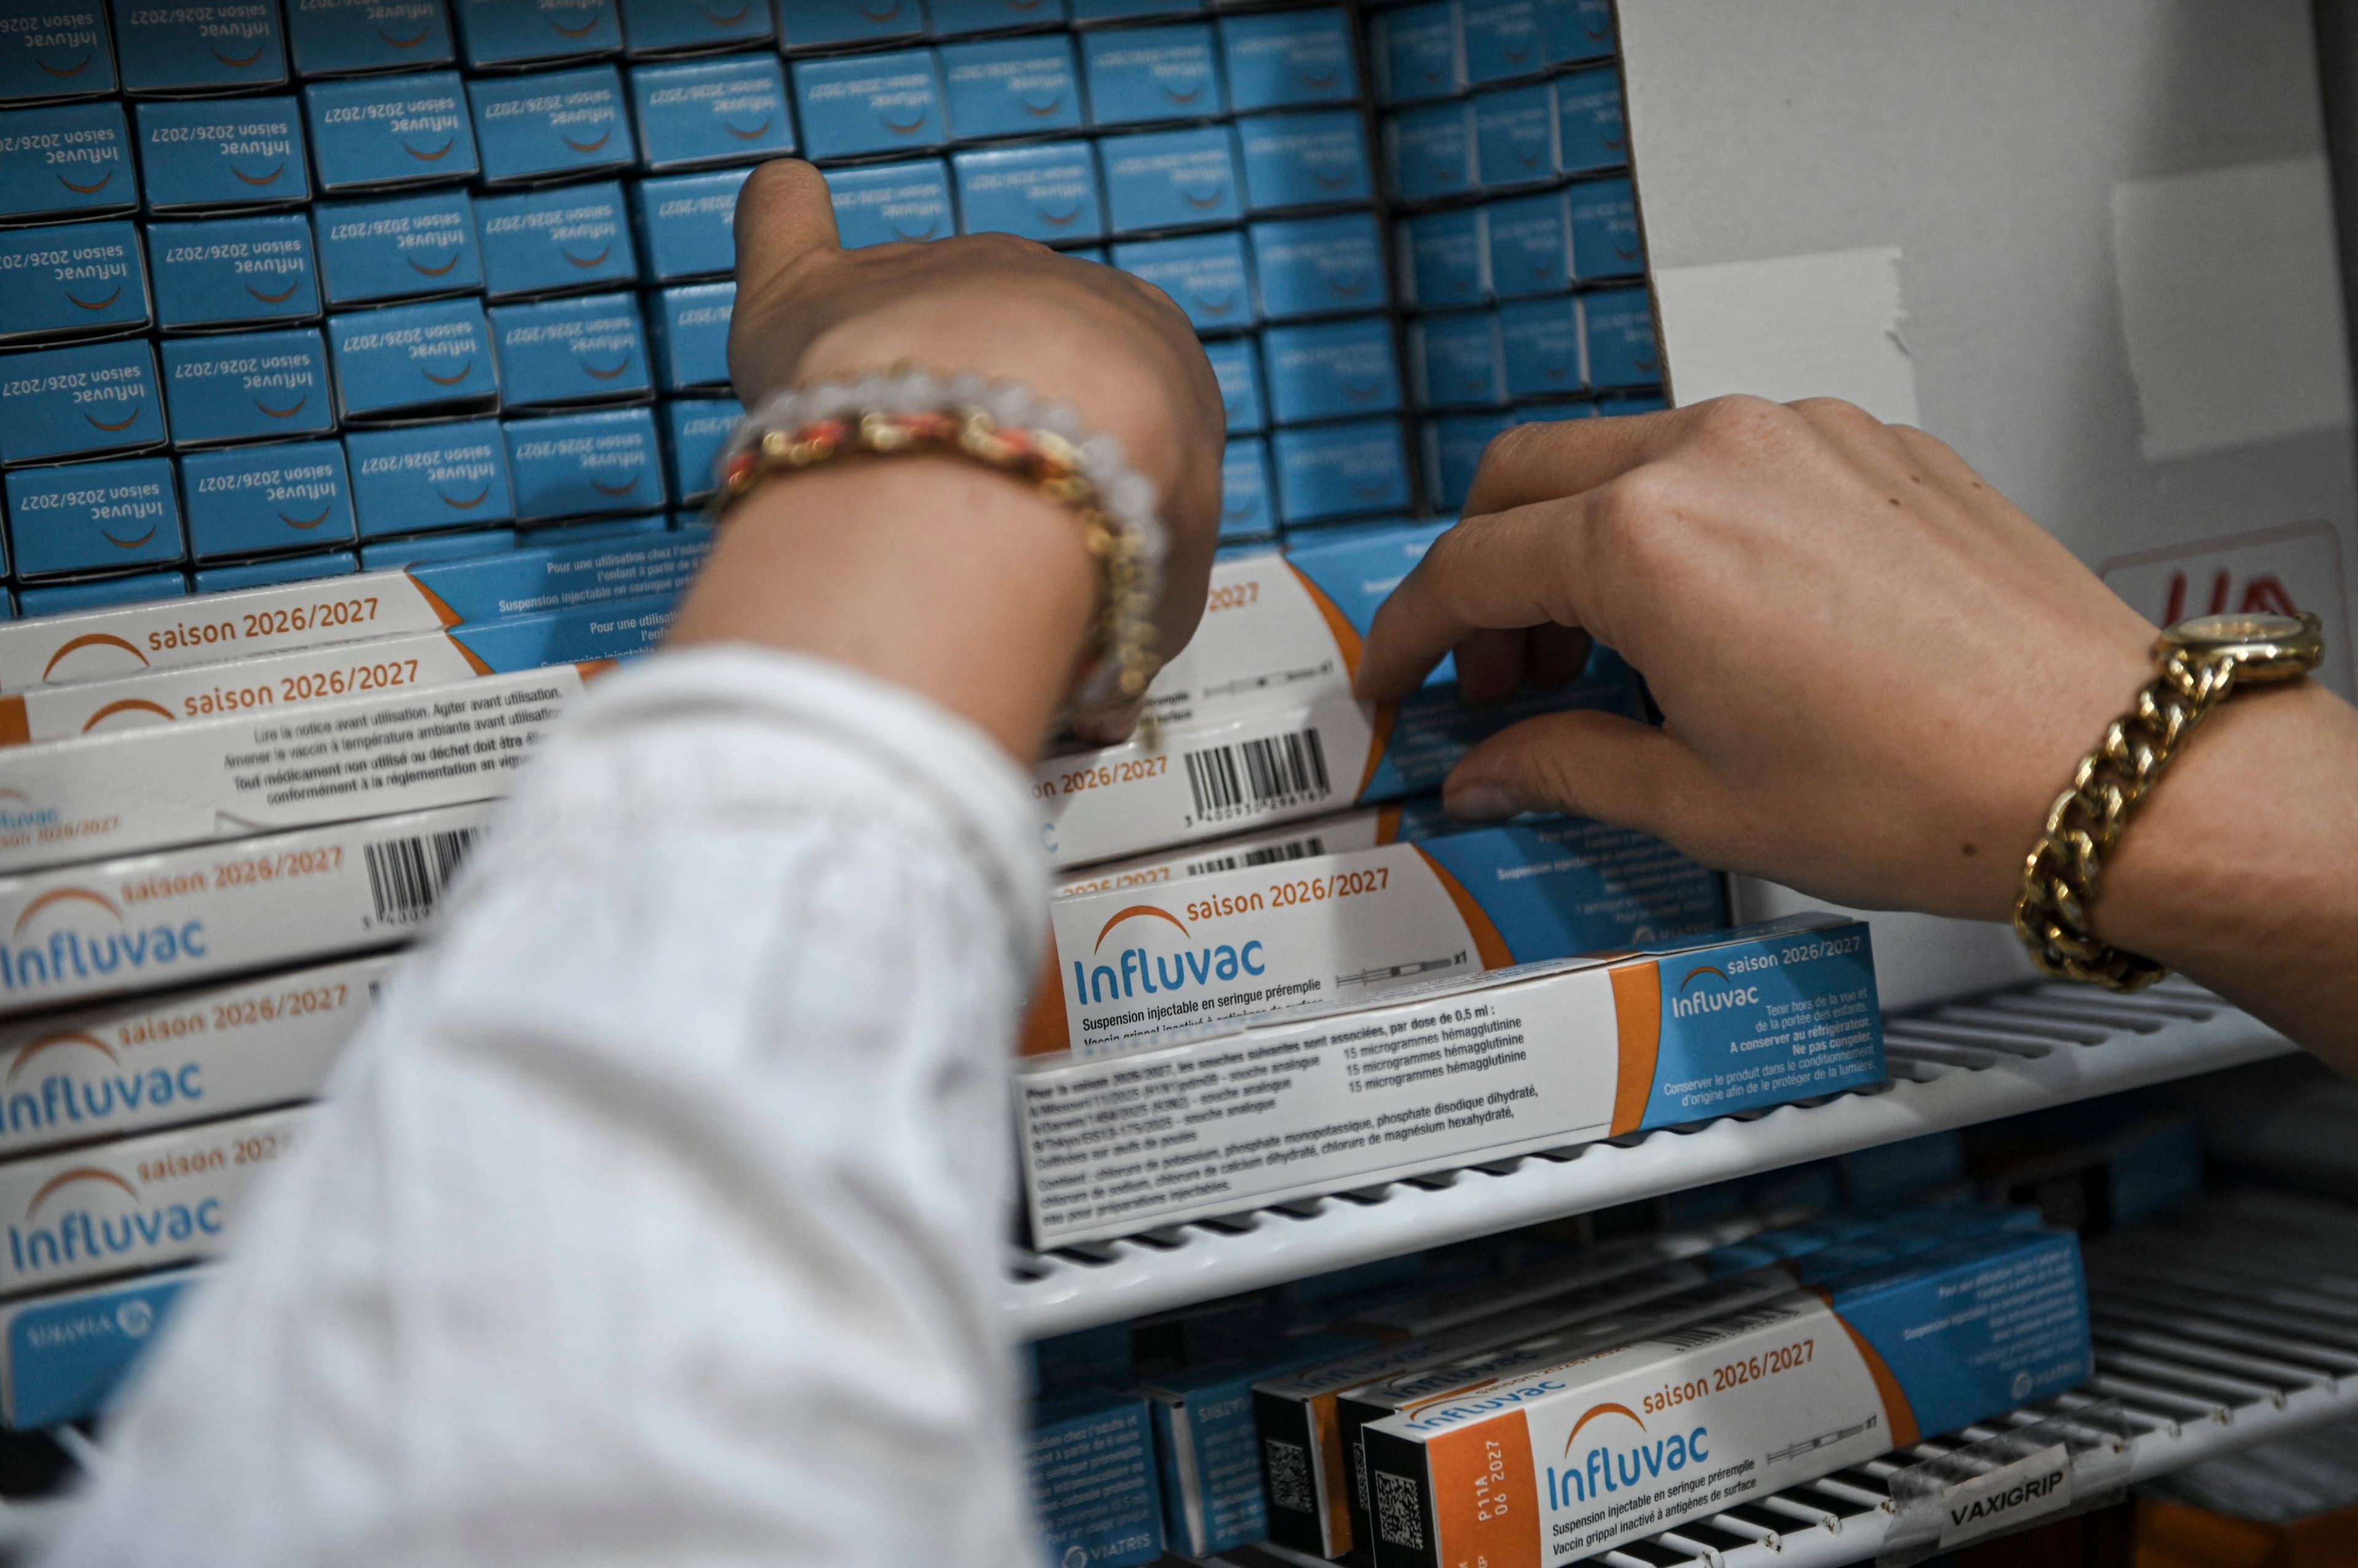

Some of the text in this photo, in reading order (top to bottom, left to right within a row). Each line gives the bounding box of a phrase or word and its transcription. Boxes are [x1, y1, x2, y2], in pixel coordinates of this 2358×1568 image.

[131, 4, 267, 24] saison 2026/2027
[200, 23, 270, 37] Influvac
[325, 98, 455, 122] saison 2026/2027
[389, 115, 458, 131] Influvac
[64, 129, 114, 142] saison
[152, 123, 287, 142] saison 2026/2027
[45, 147, 117, 163] Influvac
[220, 141, 289, 155] Influvac
[331, 213, 460, 237] saison 2026/2027
[397, 230, 464, 247] Influvac
[73, 246, 123, 259] saison
[166, 240, 300, 262] saison 2026/2027
[234, 257, 303, 273] Influvac
[55, 263, 126, 279] Influvac
[343, 322, 472, 351] saison 2026/2027
[408, 340, 476, 359] Influvac
[3, 367, 140, 394] saison 2026/2027
[176, 355, 309, 378] saison 2026/2027
[244, 372, 313, 389] Influvac
[73, 384, 144, 404] Influvac
[362, 445, 491, 474] saison 2026/2027
[427, 462, 493, 480] Influvac
[198, 464, 332, 492] saison 2026/2027
[267, 483, 335, 501] Influvac
[21, 484, 159, 511] saison 2026/2027
[91, 502, 162, 521] Influvac
[547, 560, 592, 575] Pour une
[499, 584, 610, 612] Suspension injectable
[149, 597, 379, 651] saison 2026/2027
[590, 620, 636, 634] Pour une
[185, 658, 418, 716] saison 2026/2027
[254, 729, 277, 745] Lire
[433, 701, 466, 718] Agiter
[470, 695, 502, 711] avant
[504, 688, 561, 705] utilisation.
[417, 715, 505, 739] ambiante avant
[429, 743, 471, 760] déchet
[473, 739, 496, 753] doit
[499, 734, 522, 749] être
[1061, 756, 1169, 794] 2026/2027
[122, 847, 343, 904] saison 2026/2027
[1186, 867, 1388, 921] saison 2026/2027
[0, 921, 206, 990] Influvac
[1728, 936, 1861, 974] saison 2026/2027
[1074, 939, 1265, 1006] Influvac
[118, 985, 348, 1047] saison 2026/2027
[1083, 1011, 1144, 1031] Suspension
[1148, 1001, 1198, 1022] injectable
[1202, 998, 1215, 1009] en
[1218, 992, 1263, 1011] seringue
[1266, 979, 1321, 1000] préremplie
[1672, 987, 1759, 1018] Influvac
[1765, 988, 1867, 1017] Tenir hors de la vue et
[1331, 1005, 1489, 1044] associées, par dose de 0,5 ml
[1730, 1017, 1872, 1054] A conserver au réfrigérateur.
[1756, 1022, 1768, 1033] de
[1770, 1019, 1779, 1030] la
[1782, 1012, 1811, 1030] portée
[1814, 1009, 1830, 1020] des
[1344, 1018, 1522, 1060] 15 microgrammes hémagglutinine
[1793, 1031, 1873, 1056] Ne pas congeler.
[1347, 1034, 1524, 1076] 15 microgrammes hémagglutinine
[1350, 1050, 1527, 1093] 15 microgrammes hémagglutinine
[1664, 1045, 1875, 1096] Conserver le produit dans le conditionnement
[1682, 1059, 1877, 1107] d'origine afin de le protéger de la lumière.
[0, 1063, 201, 1135] nfluvac
[1377, 1085, 1538, 1129] phosphate disodique dihydraté,
[1385, 1107, 1514, 1143] magnésium hexahydraté,
[138, 1152, 225, 1181] saison
[9, 1197, 222, 1272] Influvac
[1643, 1338, 1815, 1416] saison 2026/2027
[1405, 1381, 1566, 1430] Influvac
[1486, 1441, 1508, 1516] 06 2027
[1547, 1427, 1709, 1511] Influvac
[1476, 1475, 1492, 1522] P11A
[1553, 1459, 1754, 1537] Suspension injectable en seringue préremplie
[1950, 1471, 2063, 1527] VAXIGRIP
[1553, 1478, 1757, 1556] Vaccin grippal inactivé à antigènes de surface
